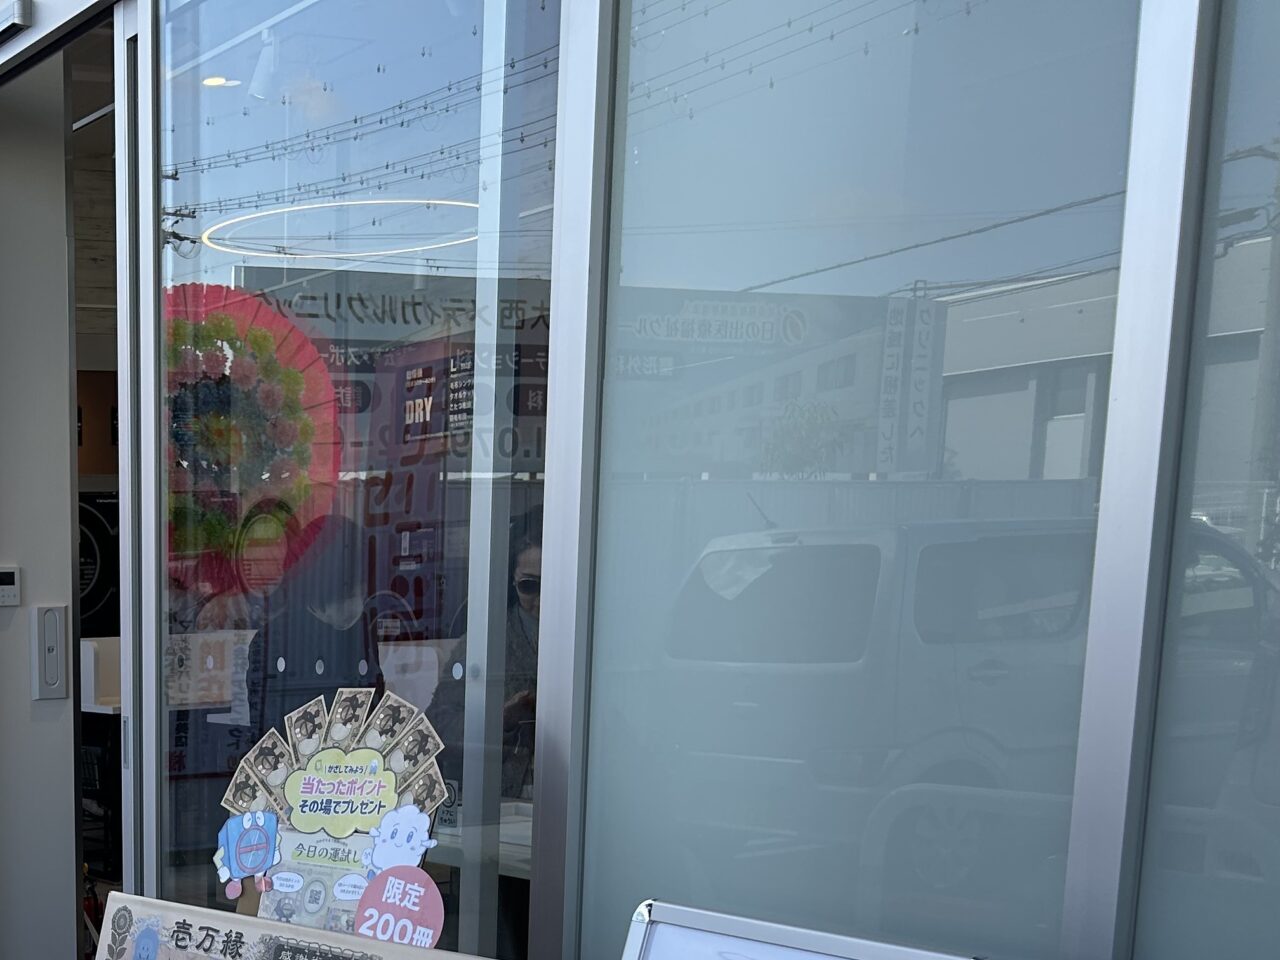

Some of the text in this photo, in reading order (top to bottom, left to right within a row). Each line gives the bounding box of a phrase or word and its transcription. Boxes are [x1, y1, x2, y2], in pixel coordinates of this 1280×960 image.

[405, 396, 433, 425] DRY
[300, 777, 387, 797] 当たったポイント
[298, 799, 387, 816] その場でプレゼント
[294, 842, 360, 864] 今日の運試し
[381, 875, 426, 912] 限定
[170, 918, 246, 960] 壱万縁
